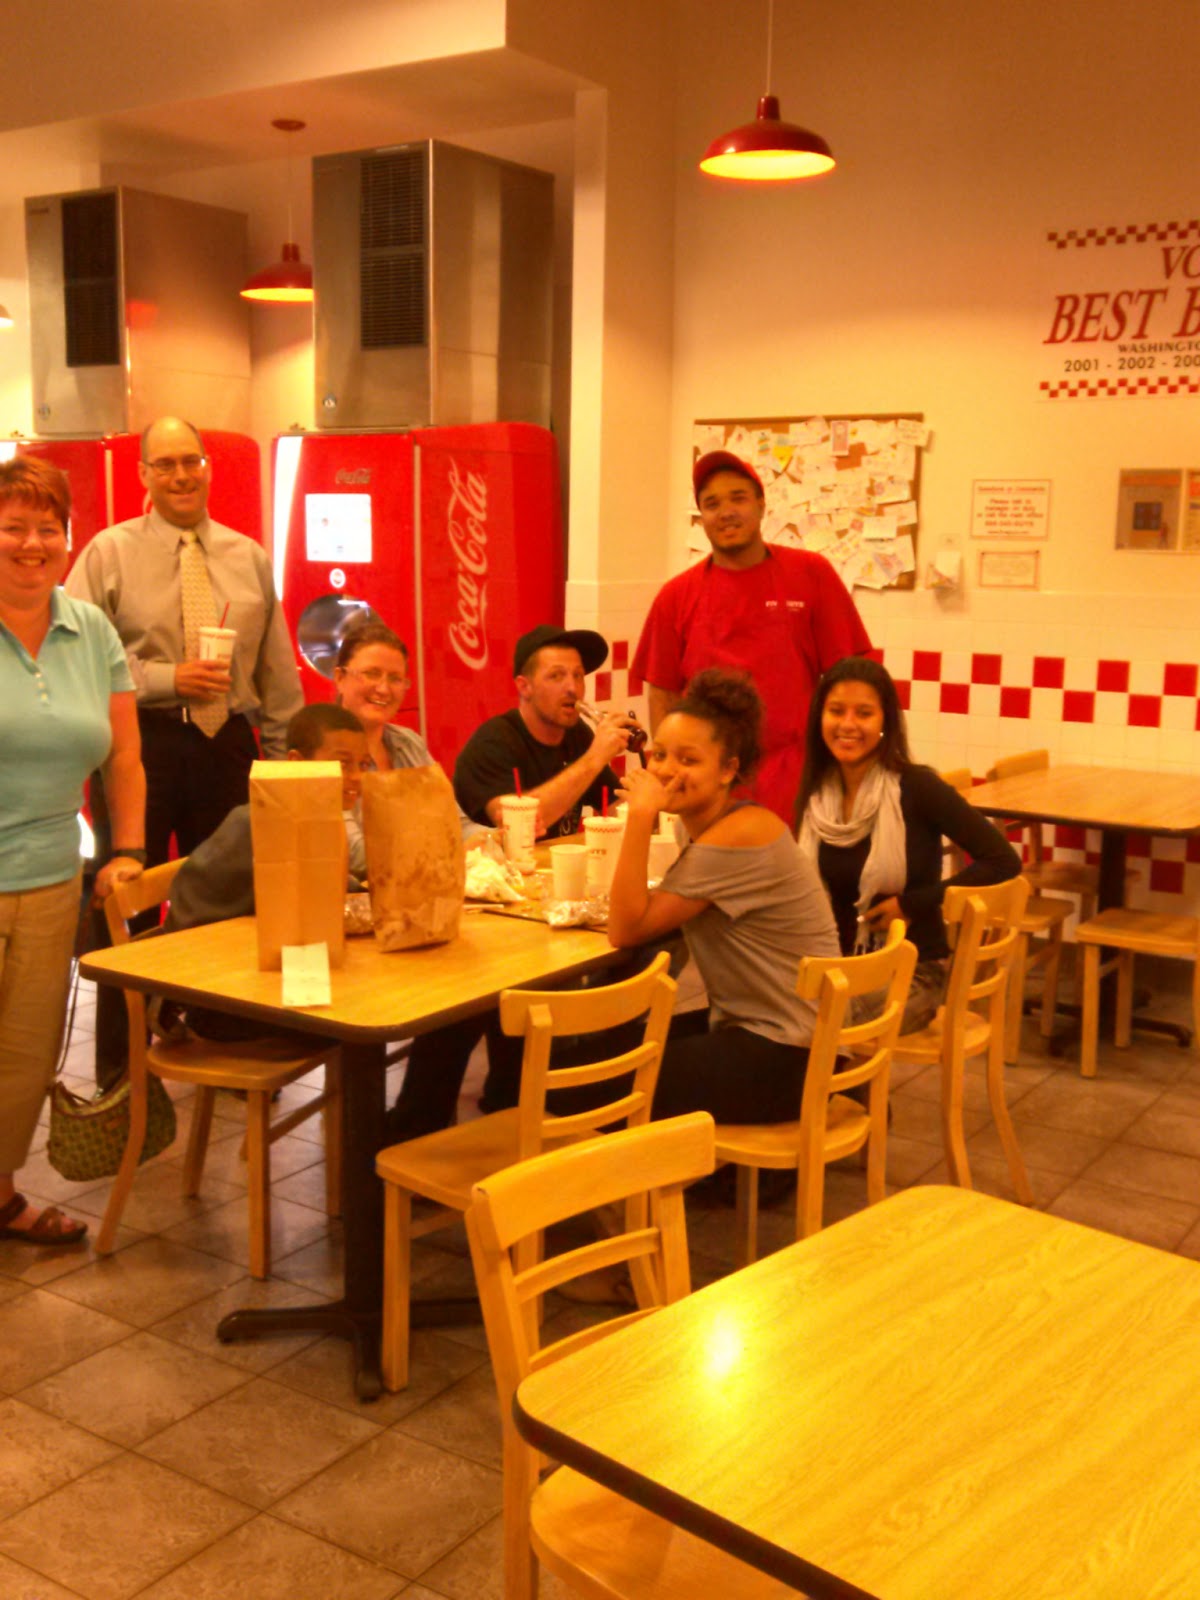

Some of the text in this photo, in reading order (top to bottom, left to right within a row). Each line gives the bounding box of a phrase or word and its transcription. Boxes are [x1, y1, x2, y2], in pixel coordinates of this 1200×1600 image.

[1042, 287, 1169, 345] BEST
[1064, 358, 1099, 372] 2001
[1118, 356, 1156, 370] 2002
[447, 455, 488, 670] Coca-Cola
